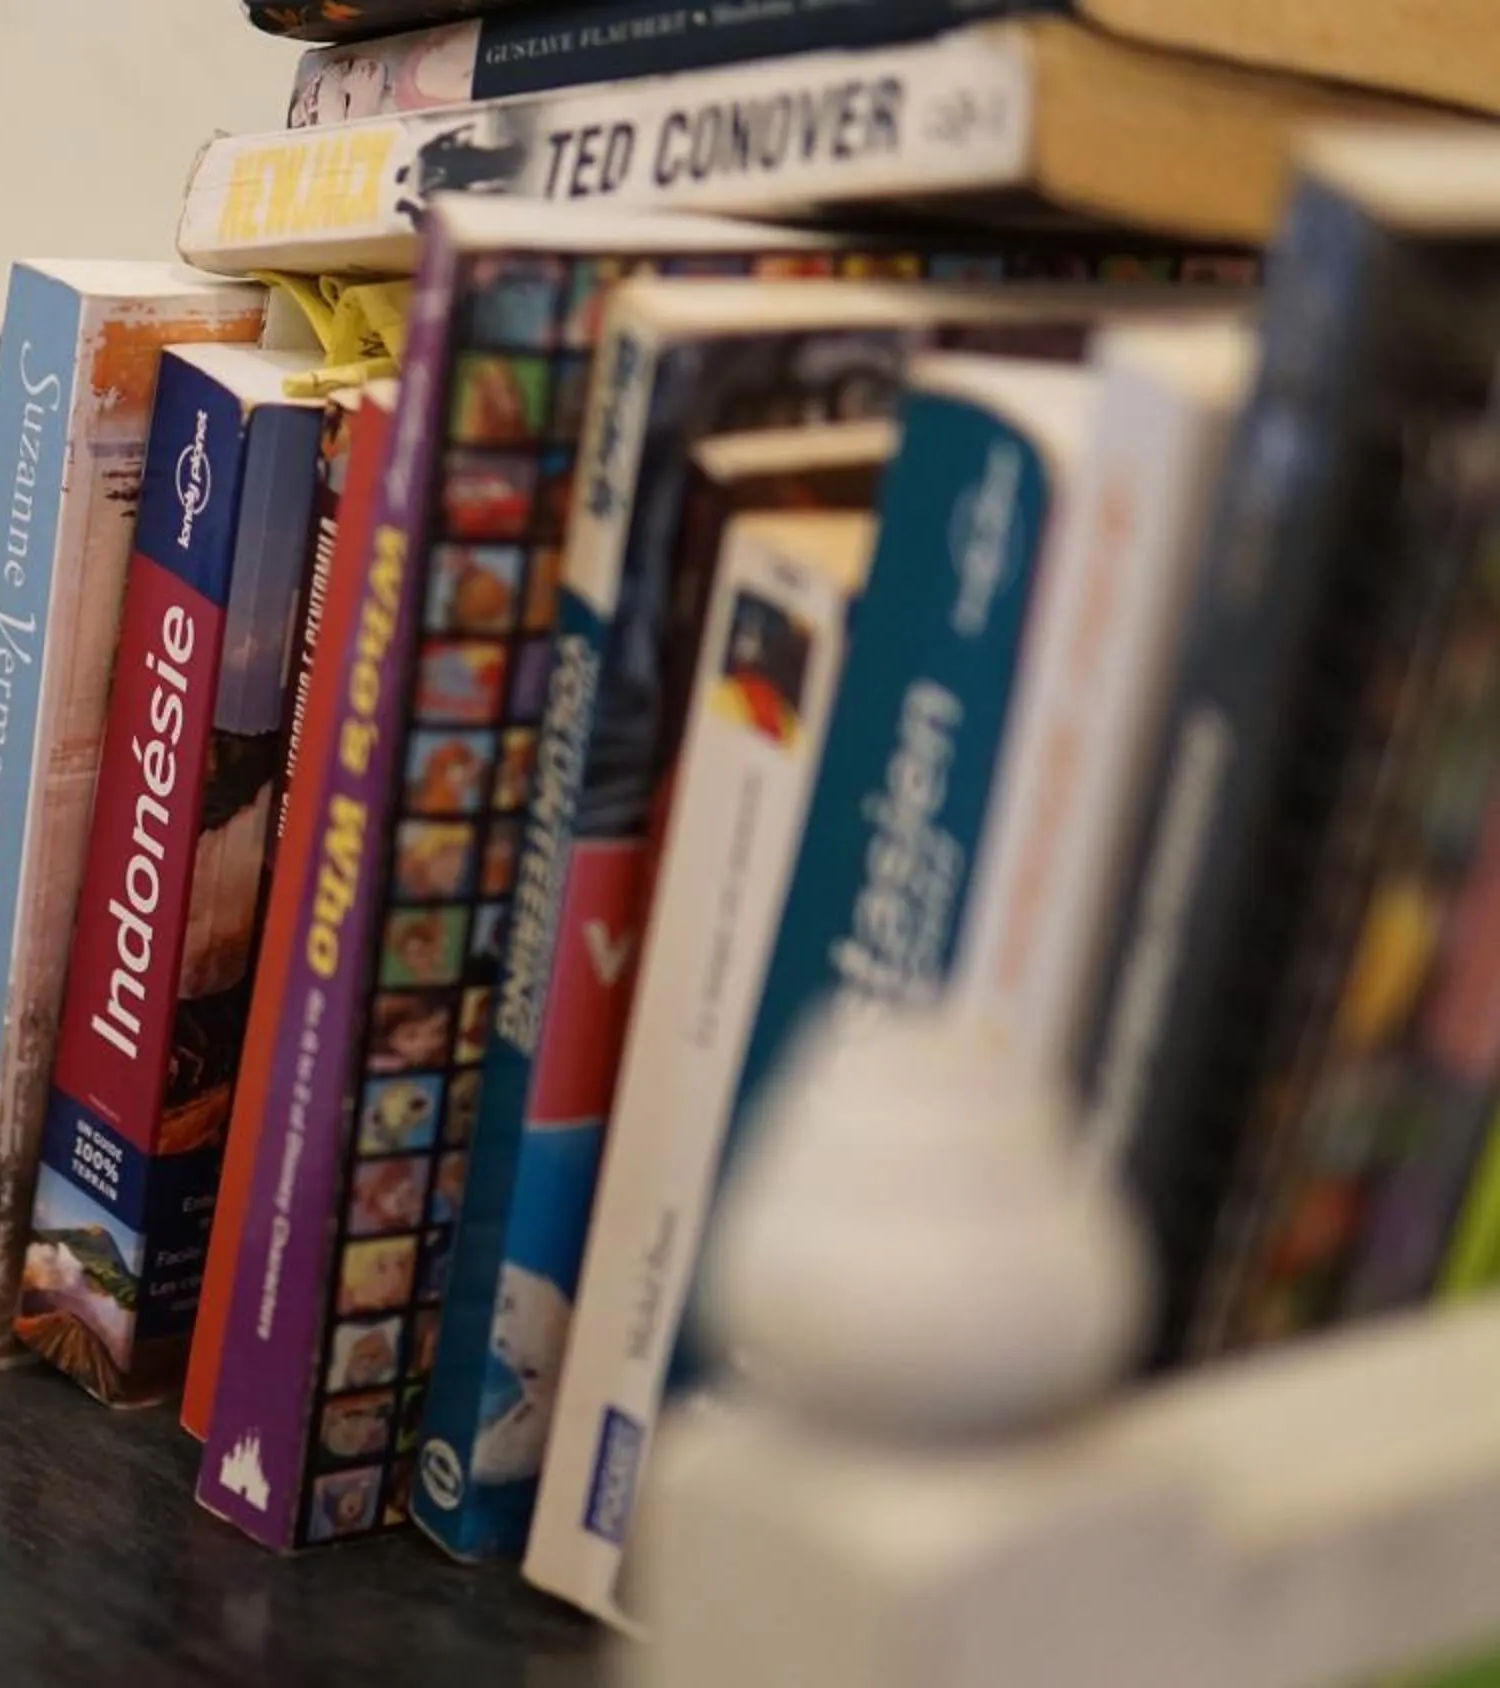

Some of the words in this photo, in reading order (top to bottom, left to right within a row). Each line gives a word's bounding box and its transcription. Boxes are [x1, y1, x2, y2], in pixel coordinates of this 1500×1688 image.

[545, 120, 637, 199] TED
[652, 76, 908, 189] CONOVER
[2, 340, 62, 588] Suzanne
[188, 408, 208, 483] planet
[177, 482, 201, 550] lonely
[91, 604, 195, 1060] Indonésie
[828, 677, 964, 992] tasien
[74, 1135, 120, 1184] 100%
